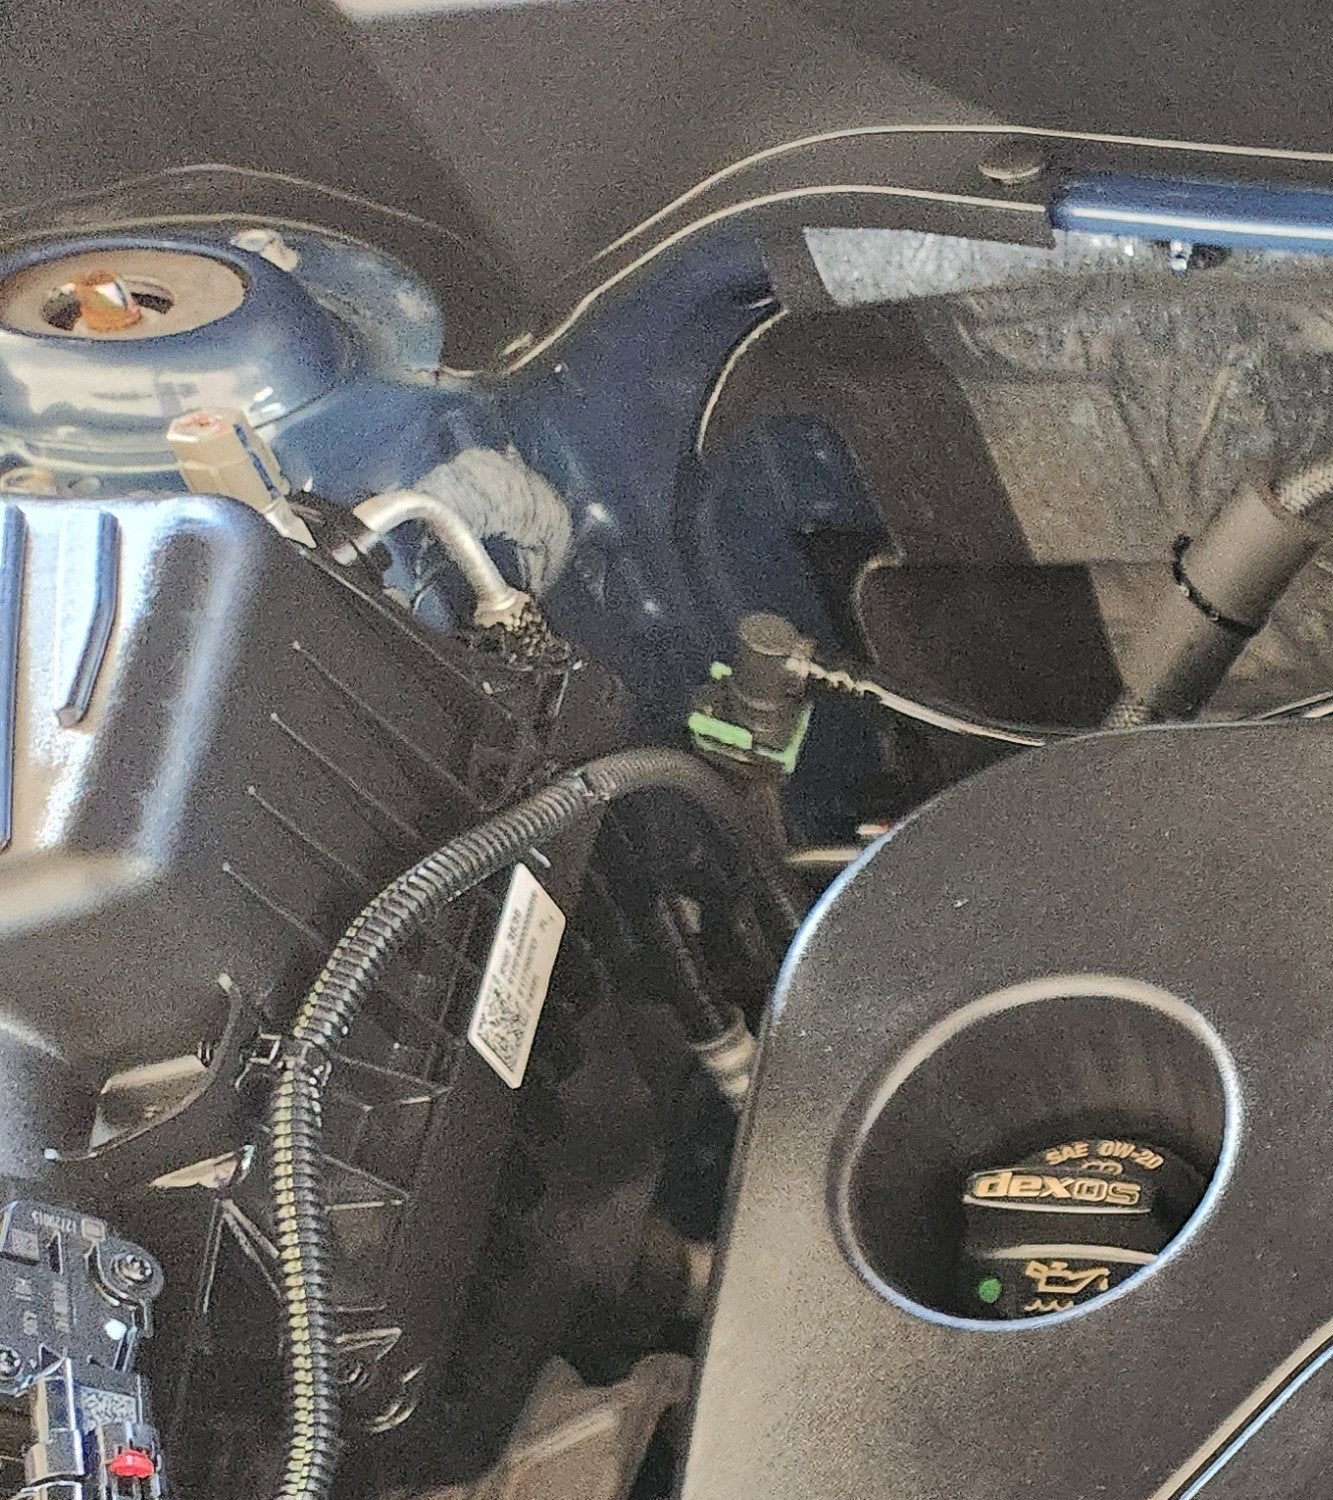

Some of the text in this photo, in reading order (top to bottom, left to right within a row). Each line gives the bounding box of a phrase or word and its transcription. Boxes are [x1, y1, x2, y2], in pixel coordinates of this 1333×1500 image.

[1045, 1140, 1164, 1170] SAE 0W-20
[974, 1172, 1141, 1206] dexos
